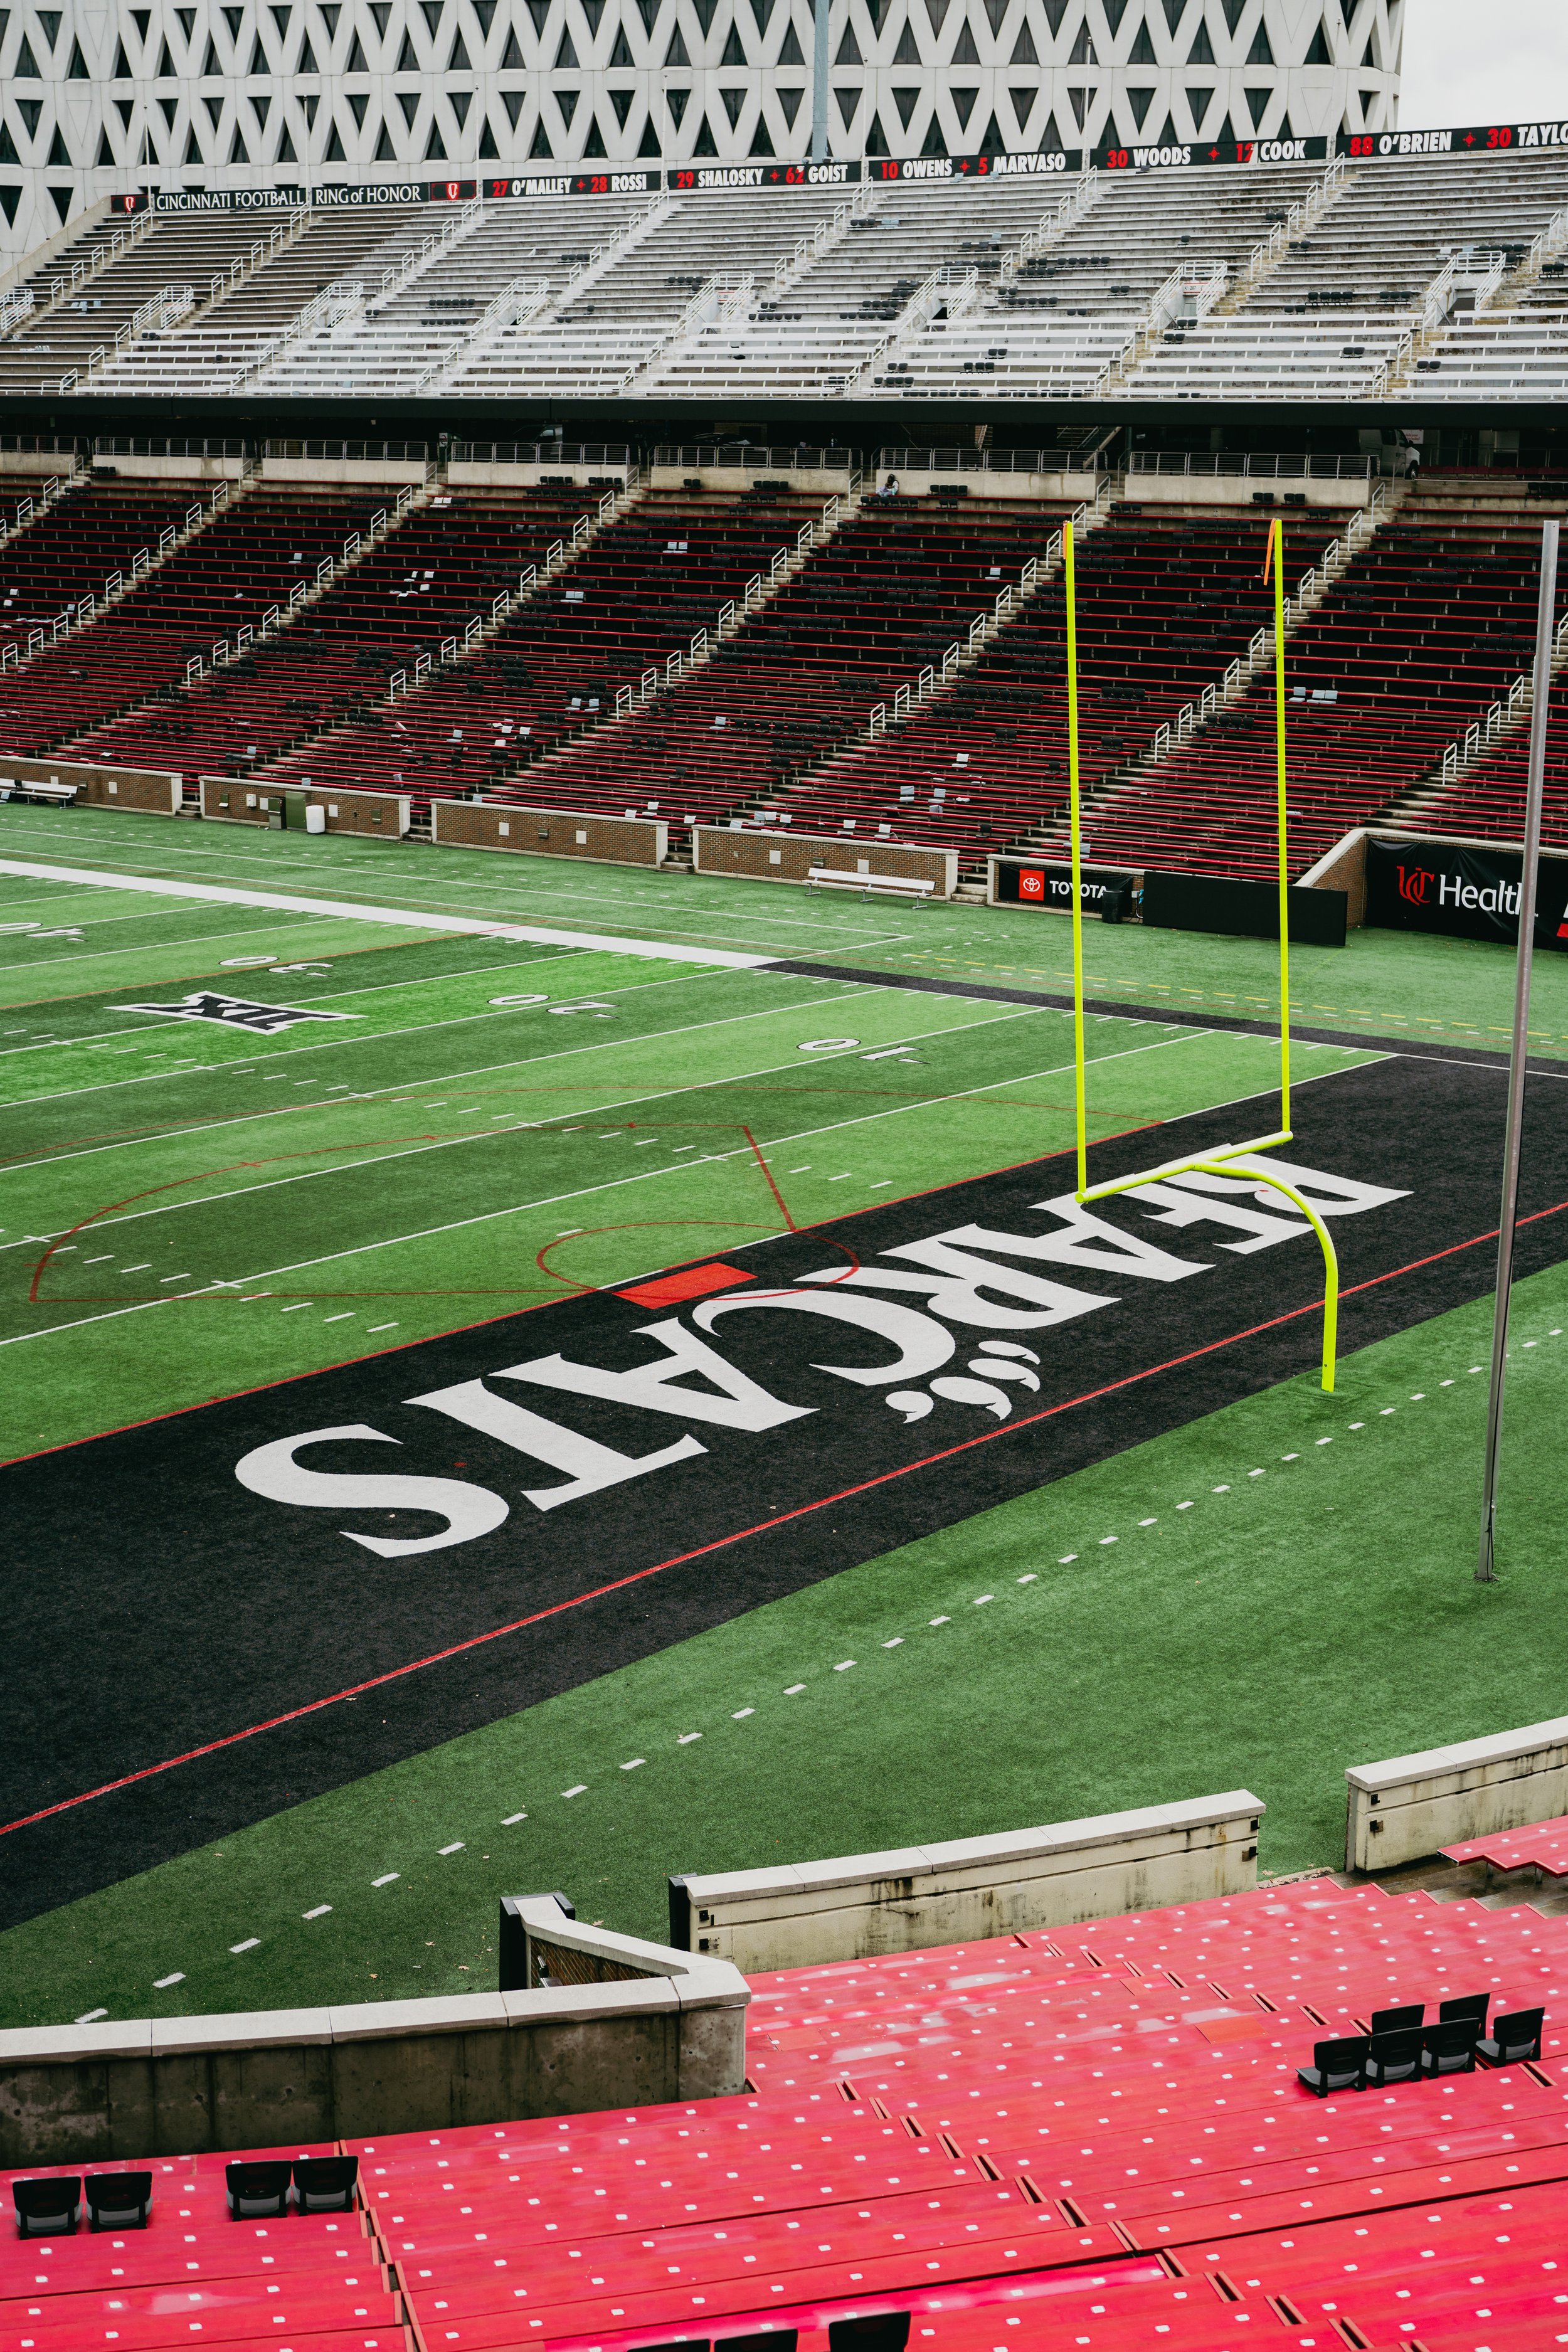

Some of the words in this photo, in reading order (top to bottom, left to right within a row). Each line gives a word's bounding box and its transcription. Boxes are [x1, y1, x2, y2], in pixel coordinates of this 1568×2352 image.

[1107, 149, 1128, 168] 30
[1133, 147, 1190, 167] WOODS
[1236, 142, 1254, 162] 12
[1260, 140, 1306, 161] COOK
[1350, 136, 1374, 156] 88
[1380, 132, 1452, 154] O'BRIEN
[1486, 128, 1512, 148] 30
[677, 171, 694, 188] 29
[698, 168, 763, 188] SHALOSKY
[785, 167, 804, 184] 62
[808, 164, 848, 183] GOIST
[881, 161, 898, 179] 10
[903, 159, 952, 178] OWENS
[978, 157, 988, 174] 5
[993, 153, 1066, 173] MARVASO
[157, 193, 231, 210] CINCINNATI
[235, 190, 304, 206] FOOTBALL
[315, 189, 349, 204] RING
[351, 188, 364, 203] of
[367, 186, 421, 203] HONOR
[492, 181, 509, 196] 27
[512, 177, 572, 196] O'MALLEY
[591, 176, 608, 193] 28
[611, 174, 647, 191] ROSSI
[235, 1143, 1415, 1558] BEARCATS
